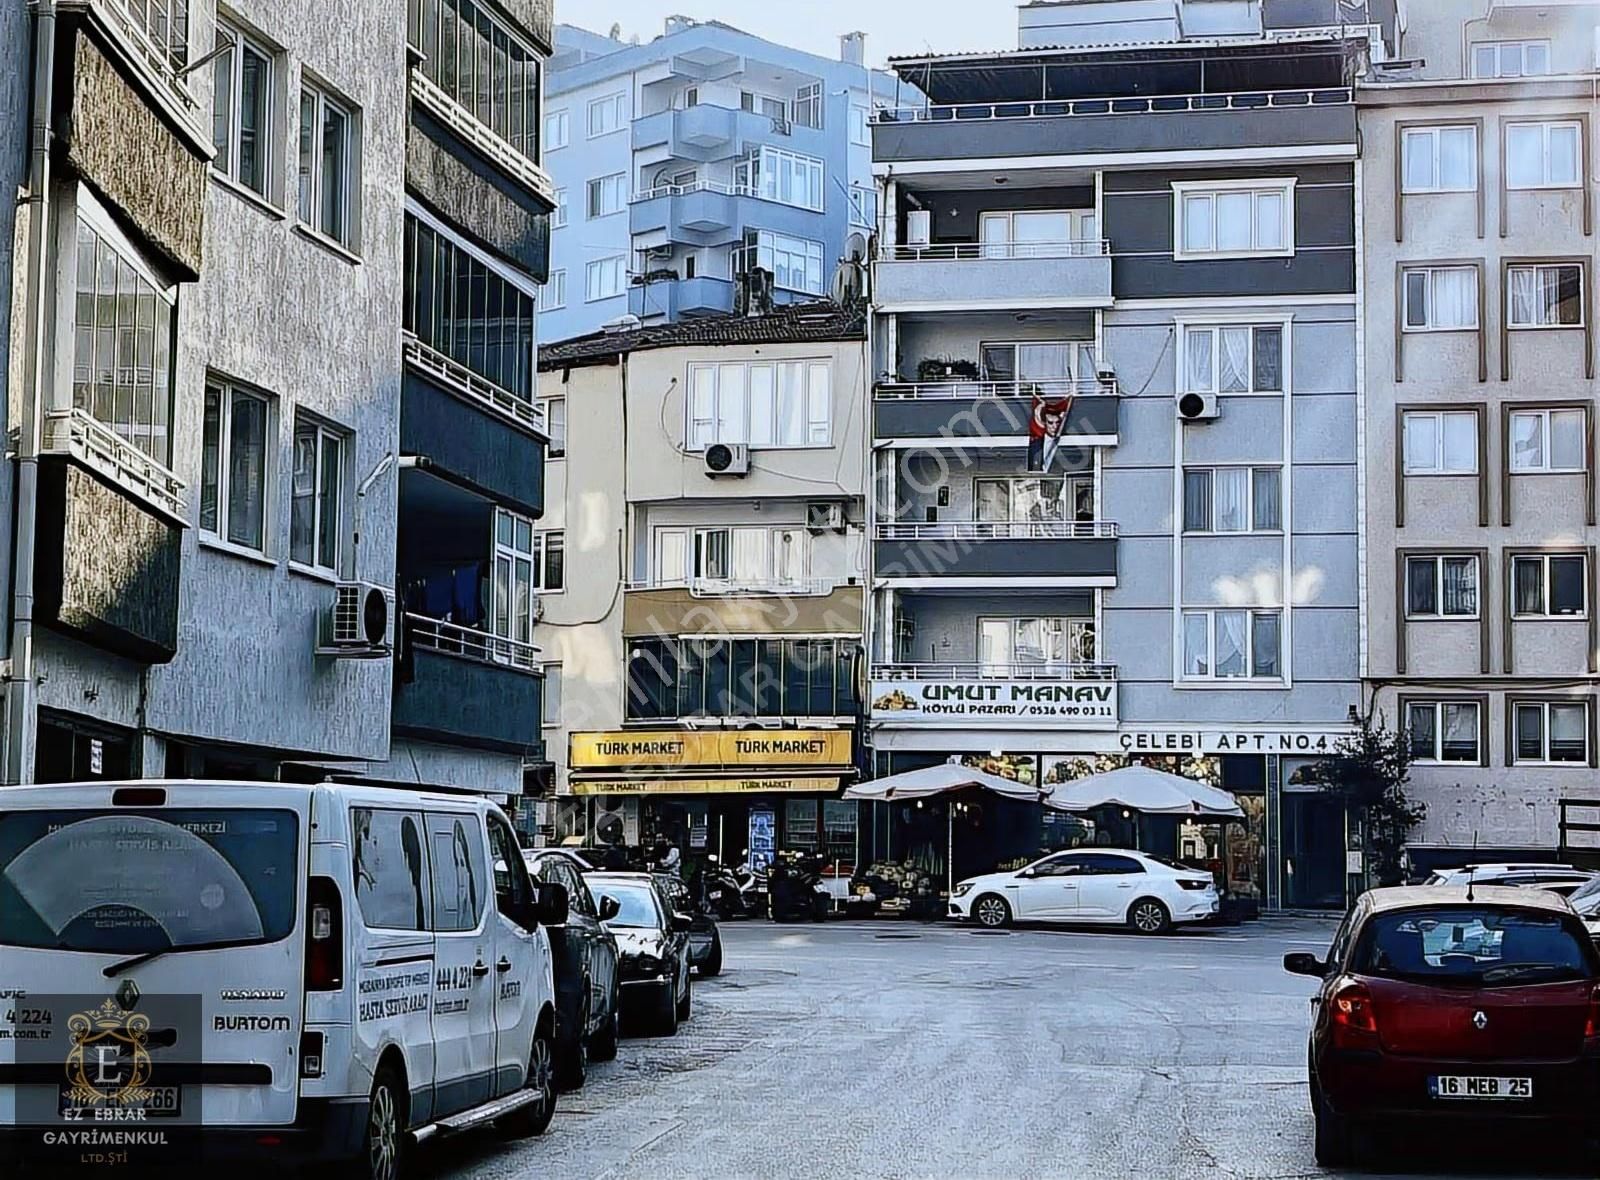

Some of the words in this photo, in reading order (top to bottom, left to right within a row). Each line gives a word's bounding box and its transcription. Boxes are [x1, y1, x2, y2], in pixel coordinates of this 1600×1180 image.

[922, 684, 1001, 701] UMUT
[1011, 685, 1113, 702] MANAV
[922, 703, 965, 714] KÖYLÜ
[969, 704, 1016, 714] PAZARI
[1100, 706, 1112, 716] 11
[596, 740, 630, 755] TÜRK
[631, 742, 684, 755] MARKET
[735, 738, 770, 753] TÜRK
[772, 740, 826, 753] MARKET
[22, 1009, 52, 1024] 224
[214, 1016, 290, 1030] BURTOM
[1440, 1078, 1459, 1094] 16
[1508, 1080, 1530, 1096] 25
